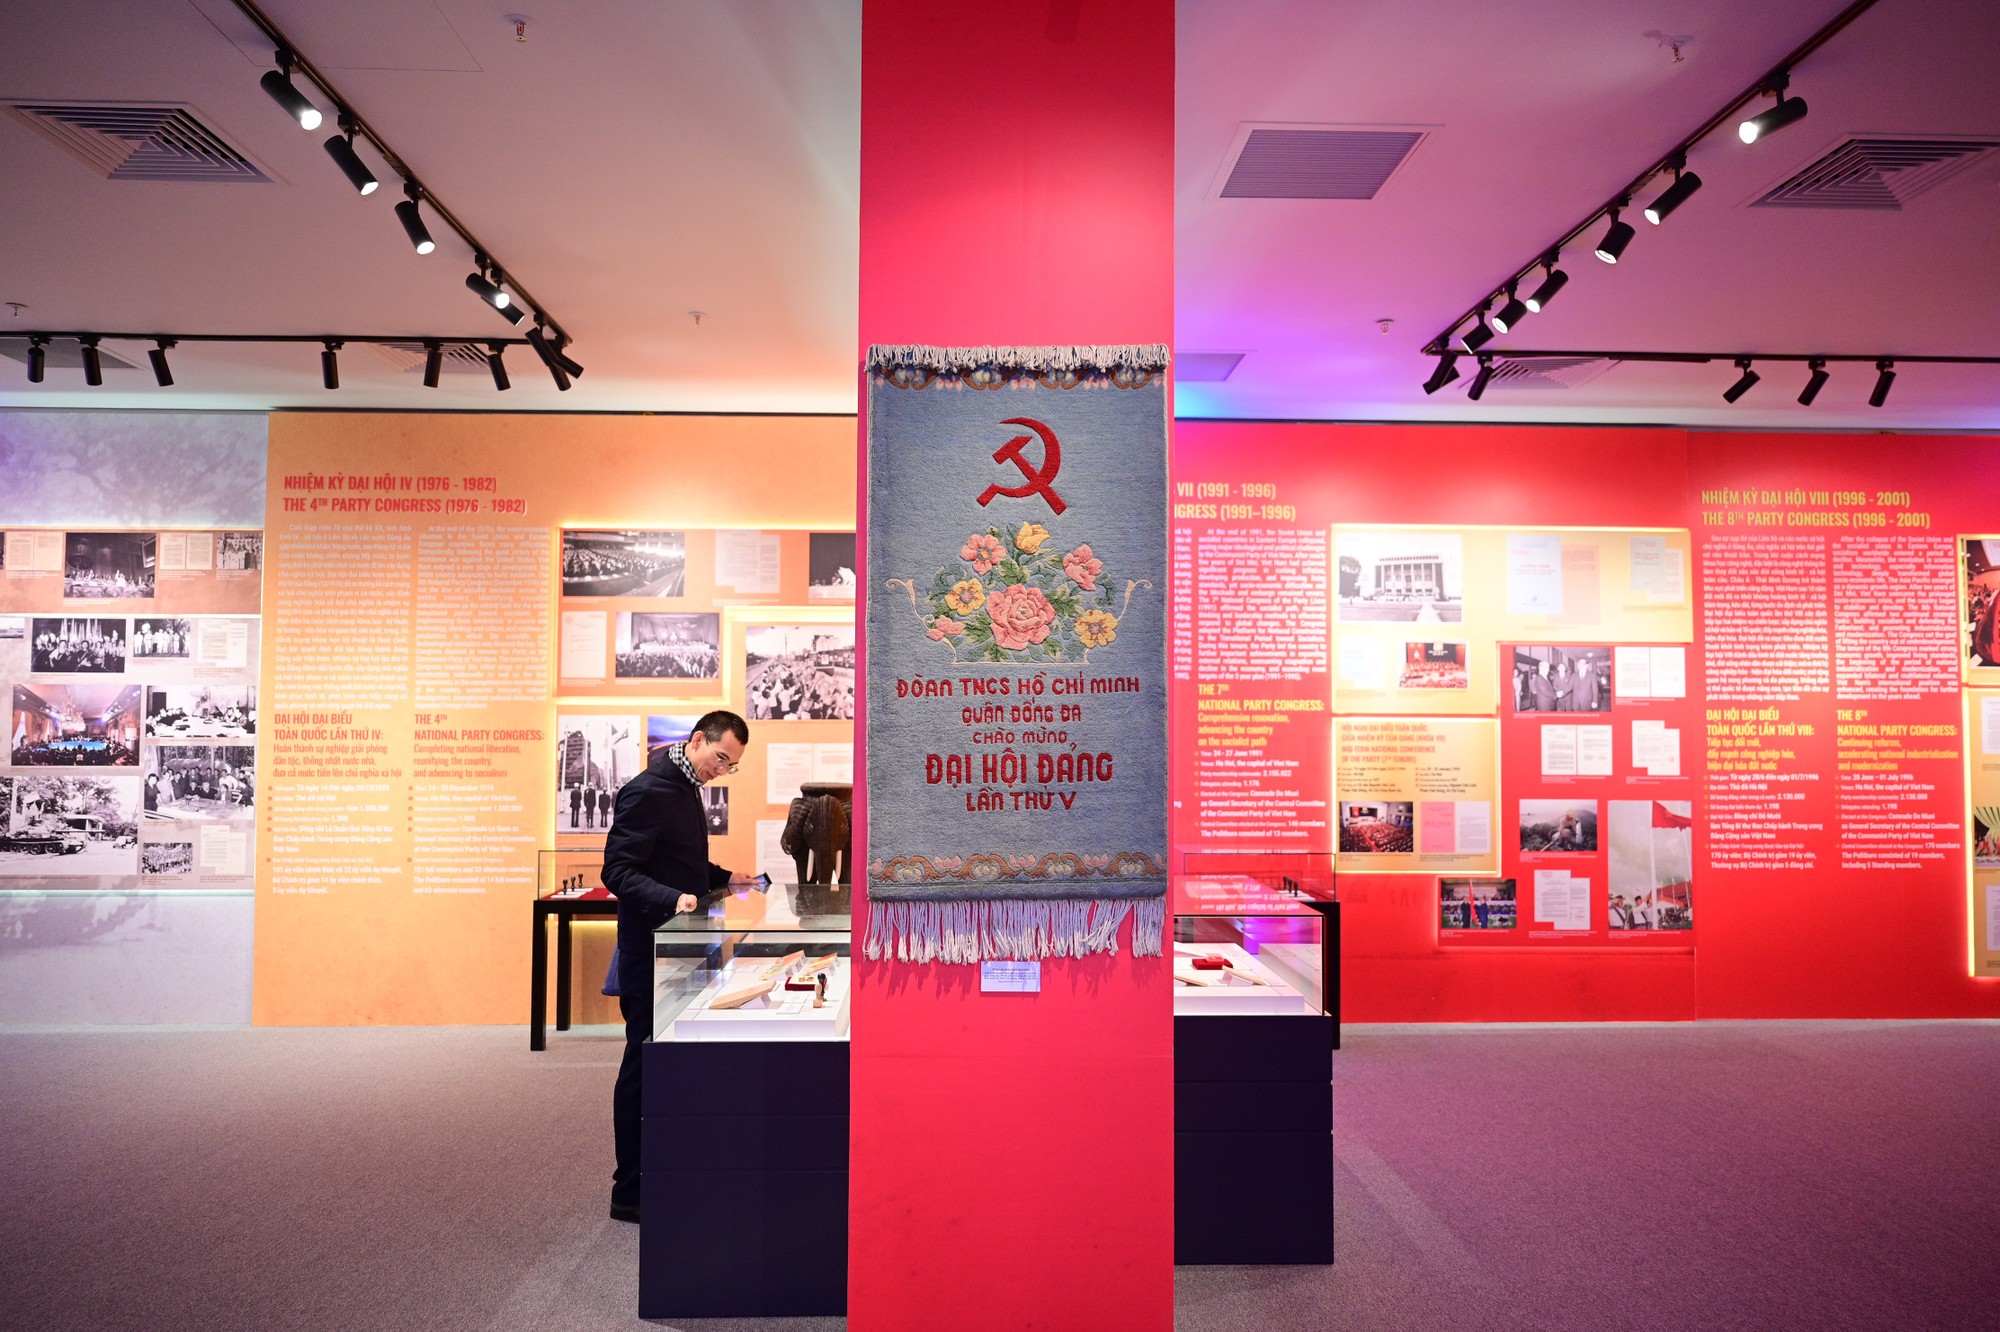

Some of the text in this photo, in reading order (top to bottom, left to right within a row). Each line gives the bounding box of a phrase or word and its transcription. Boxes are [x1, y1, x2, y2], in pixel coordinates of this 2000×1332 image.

[284, 472, 497, 494] NHIỆM KỲ ĐẠI HỘI IV (1976 1982)
[1177, 482, 1276, 500] VII (1991 1996)
[1701, 487, 1910, 508] NHIỆM KỲ ĐẠI HỘI VIII (1996 2001)
[283, 498, 306, 512] THE
[332, 498, 371, 512] PARTY
[375, 499, 442, 512] CONGRESS
[446, 499, 478, 515] (1976
[491, 499, 526, 516] 1982)
[1174, 504, 1217, 518] GRESS
[1702, 512, 1724, 526] THE
[1748, 512, 1783, 526] PARTY
[1788, 513, 1850, 526] CONGRESS
[1853, 513, 1885, 529] (1996
[1896, 513, 1930, 529] 2001)
[959, 677, 1010, 696] TNCS
[1018, 671, 1047, 695] HỒ
[1052, 671, 1085, 695] CHÍ
[1090, 676, 1140, 693] MINH
[1198, 684, 1215, 695] THE
[961, 697, 1082, 726] QUẬN ĐỐNG ĐA
[1198, 700, 1324, 711] NATIONAL PARTY CONGRESS:
[274, 710, 353, 727] ĐẠI HỘI ĐẠI BIỂU
[415, 714, 432, 725] THE
[1706, 706, 1779, 723] ĐẠI HỘI ĐẠI BIỂU
[1837, 710, 1853, 721] THE
[274, 725, 384, 741] TOÀN QUỐC LẦN THỨ IV:
[414, 730, 544, 740] NATIONAL PARTY CONGRESS:
[972, 726, 1068, 744] CHÀO MỪNG
[1198, 725, 1273, 736] advancing the country
[1706, 720, 1815, 737] TOÀN QUỐC LẦN THỨ VIII:
[1837, 725, 1958, 736] NATIONAL PARTY CONGRESS:
[414, 744, 521, 754] Completing national liberation,
[1837, 738, 1902, 748] Continuing reforms,
[414, 757, 449, 767] reunifying
[451, 757, 462, 765] the
[1838, 750, 1959, 760] accelerating national industrialization
[925, 742, 1113, 788] ĐẠI HỘI ĐẢNG
[1838, 762, 1898, 770] and modernization
[413, 769, 426, 777] and
[428, 769, 463, 779] advancing
[474, 769, 507, 777] socialism
[966, 785, 1077, 812] LẦN THỨ V
